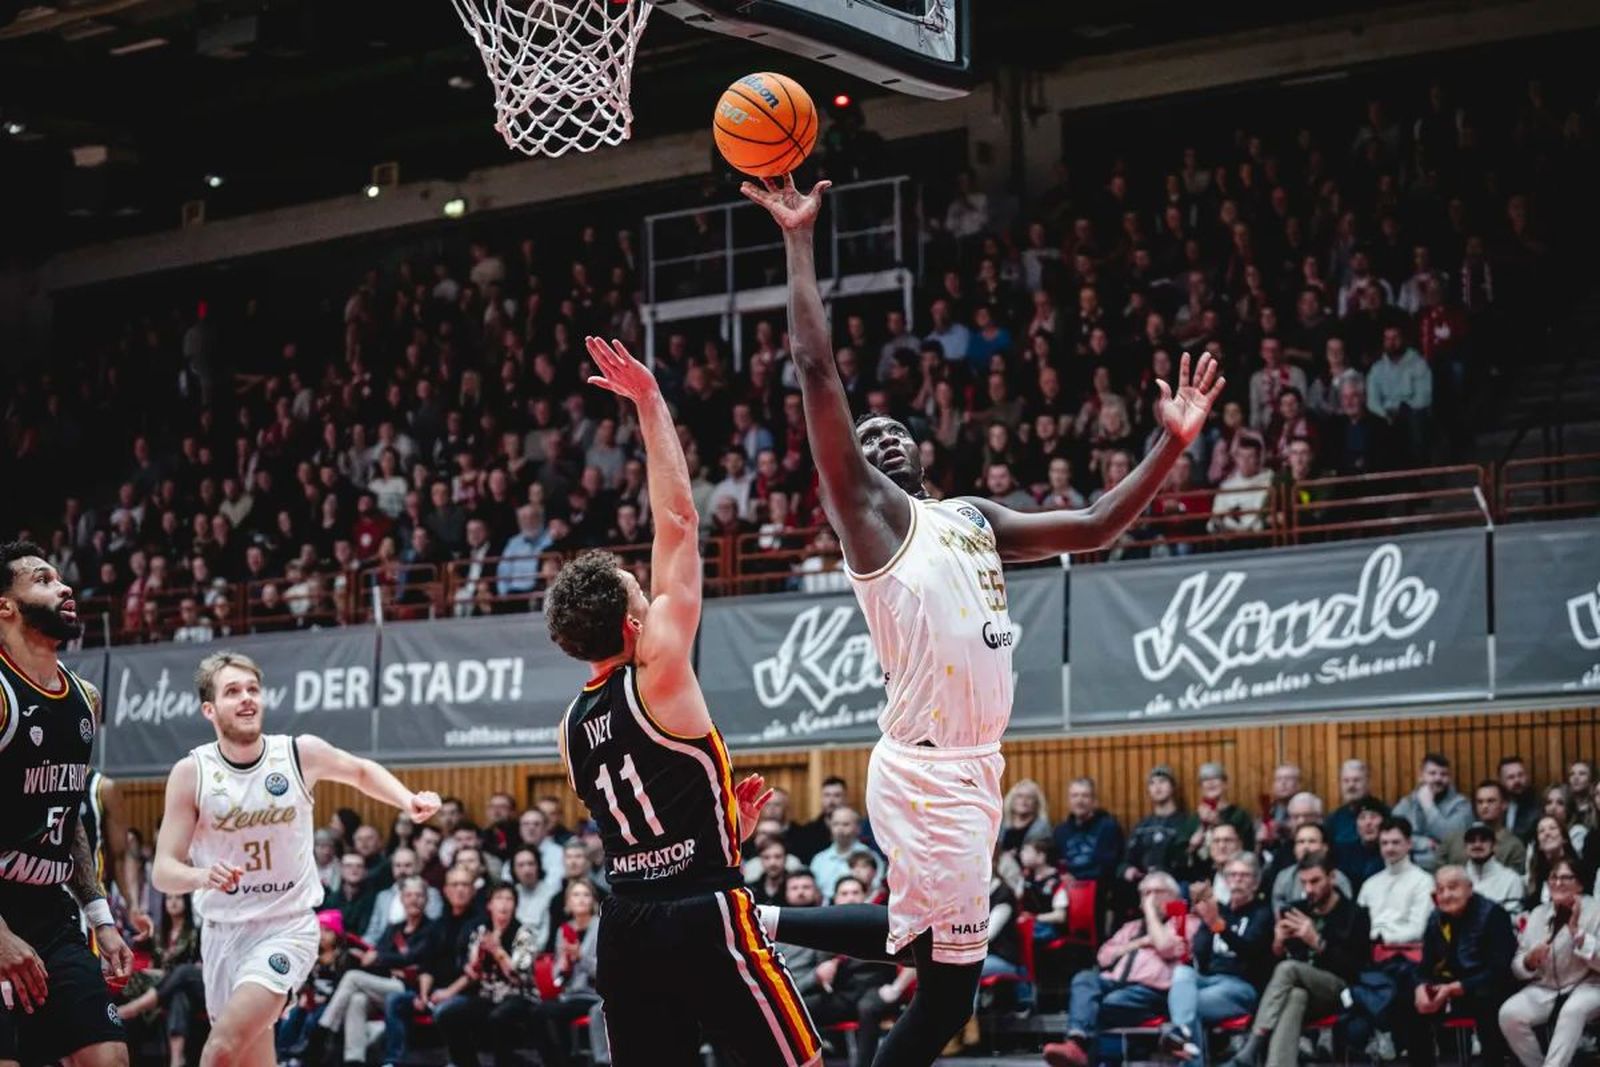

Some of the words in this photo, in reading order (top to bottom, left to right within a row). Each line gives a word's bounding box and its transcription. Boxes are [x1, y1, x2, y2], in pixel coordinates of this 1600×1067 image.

[753, 605, 886, 714] Kä
[294, 665, 370, 713] DER
[382, 657, 524, 707] STADT!
[594, 753, 666, 846] 11
[212, 803, 298, 832] Levice
[244, 839, 272, 872] 31
[611, 838, 696, 873] MERCATOR
[242, 881, 296, 894] VEOLIA
